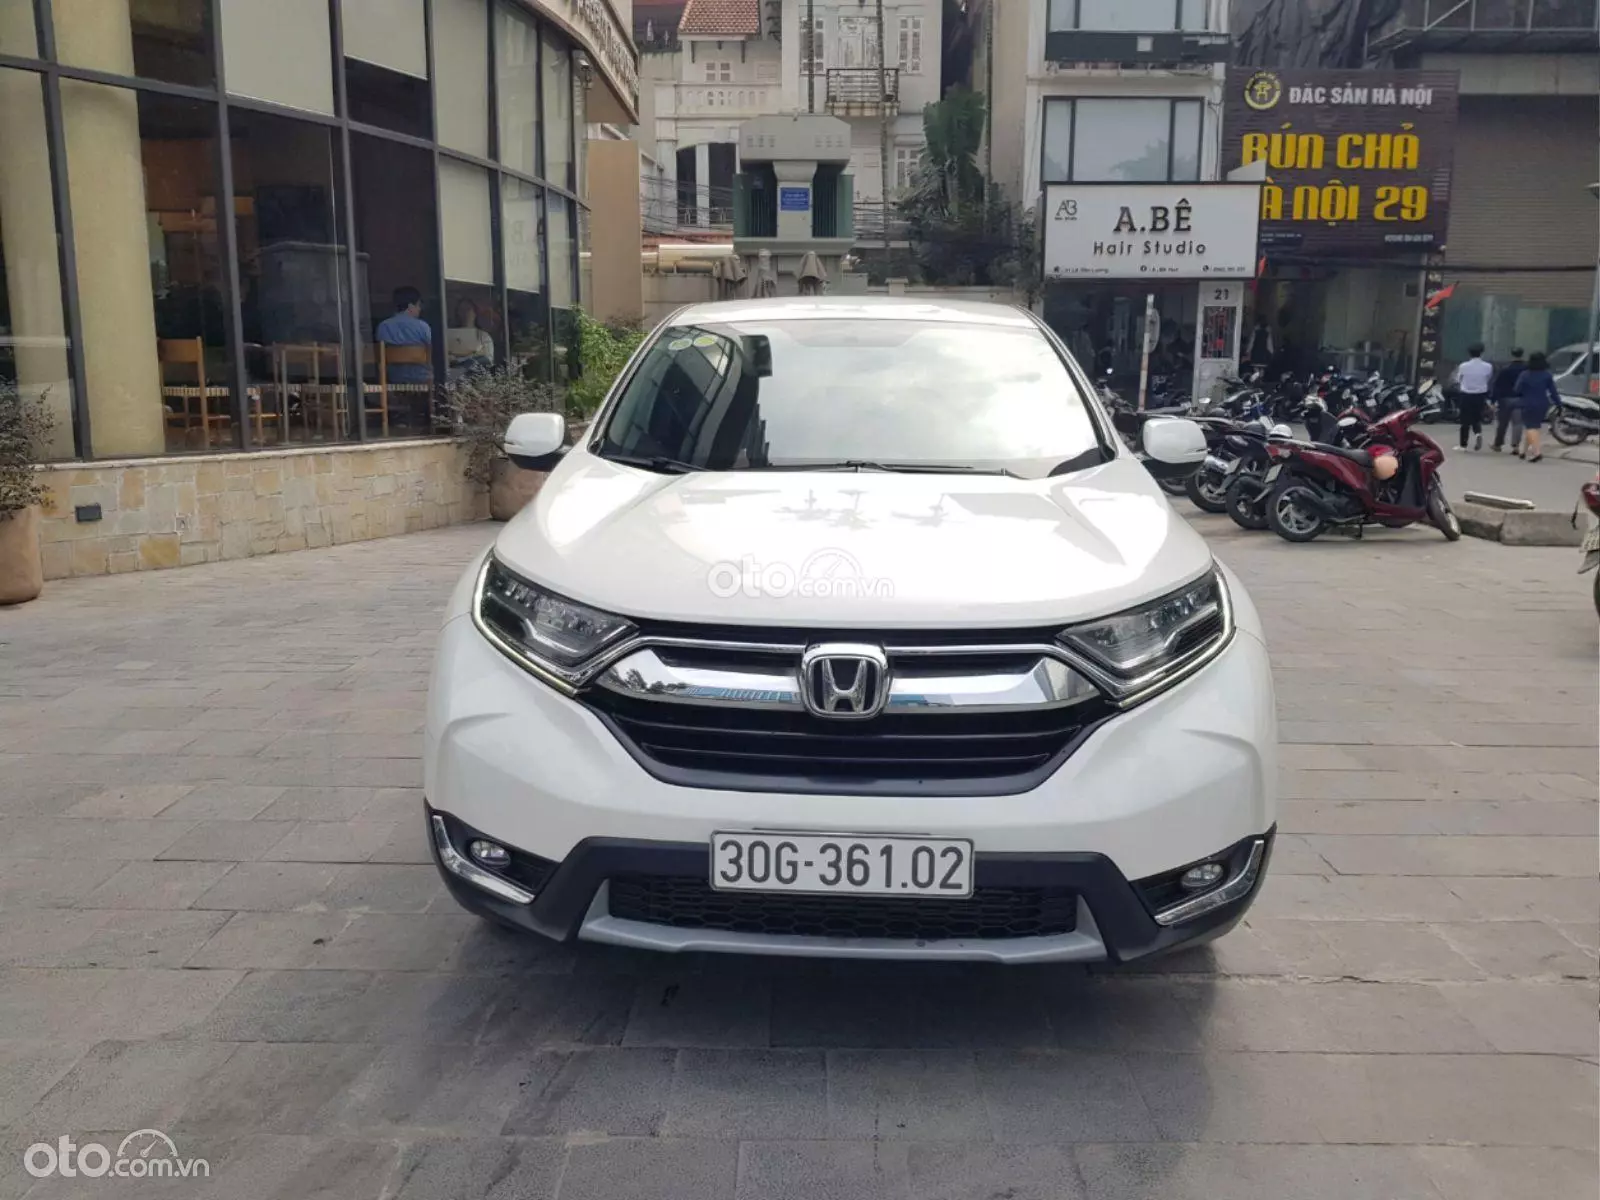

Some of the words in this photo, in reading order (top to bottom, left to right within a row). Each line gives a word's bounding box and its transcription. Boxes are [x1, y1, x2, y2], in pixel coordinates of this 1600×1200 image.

[1400, 84, 1433, 108] NỘI
[1241, 122, 1325, 169] BÚN
[1336, 122, 1420, 169] CHẢ
[1113, 197, 1193, 233] A.BÊ
[1262, 176, 1283, 220] À
[1292, 179, 1360, 226] NỘI
[1373, 184, 1428, 221] 29
[1093, 240, 1134, 256] Hair
[1143, 240, 1207, 256] Studio
[1214, 288, 1229, 300] 21
[720, 839, 964, 890] 30G-361.02
